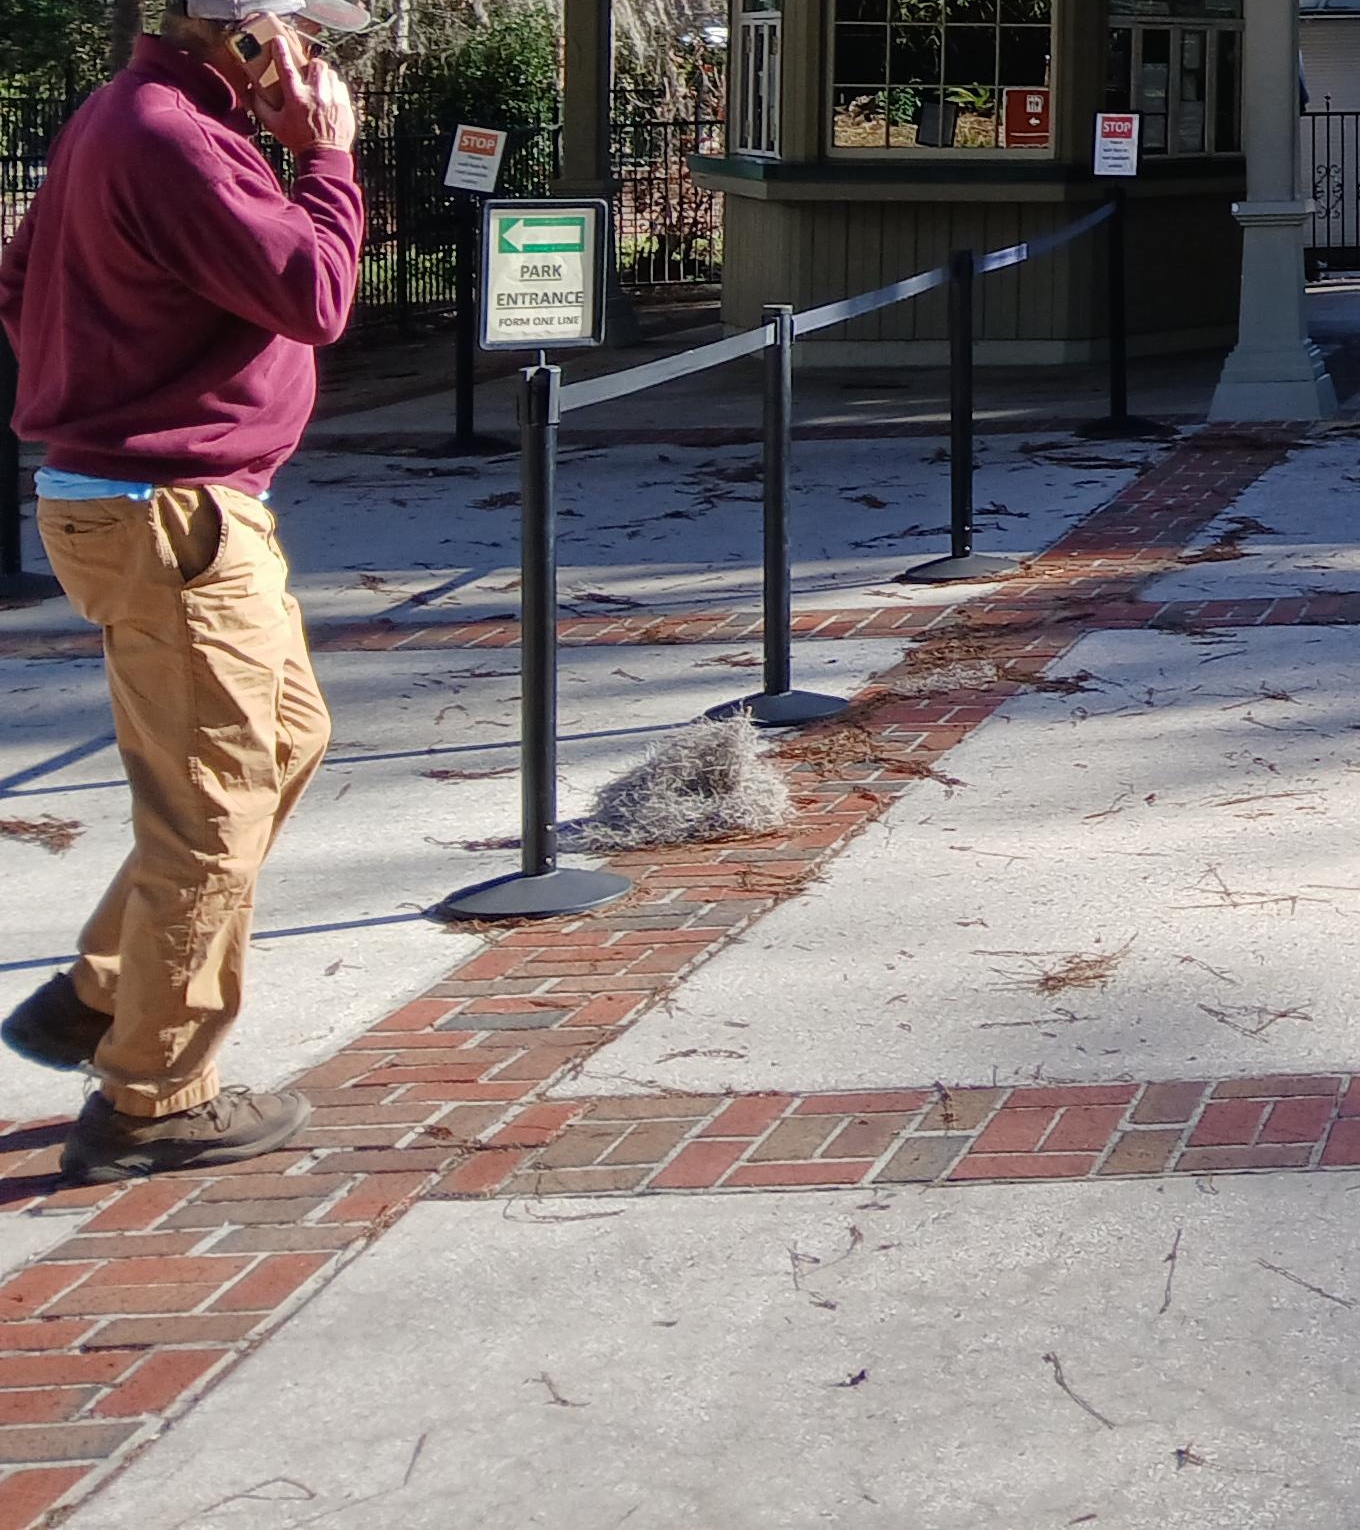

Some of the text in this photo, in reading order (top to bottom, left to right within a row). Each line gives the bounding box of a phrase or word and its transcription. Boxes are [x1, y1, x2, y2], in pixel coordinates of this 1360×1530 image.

[1103, 121, 1131, 133] STOP
[460, 134, 496, 150] STOP
[520, 264, 562, 279] PARK
[496, 291, 584, 307] ENTRANCE
[498, 315, 580, 328] FORM ONE LINE
